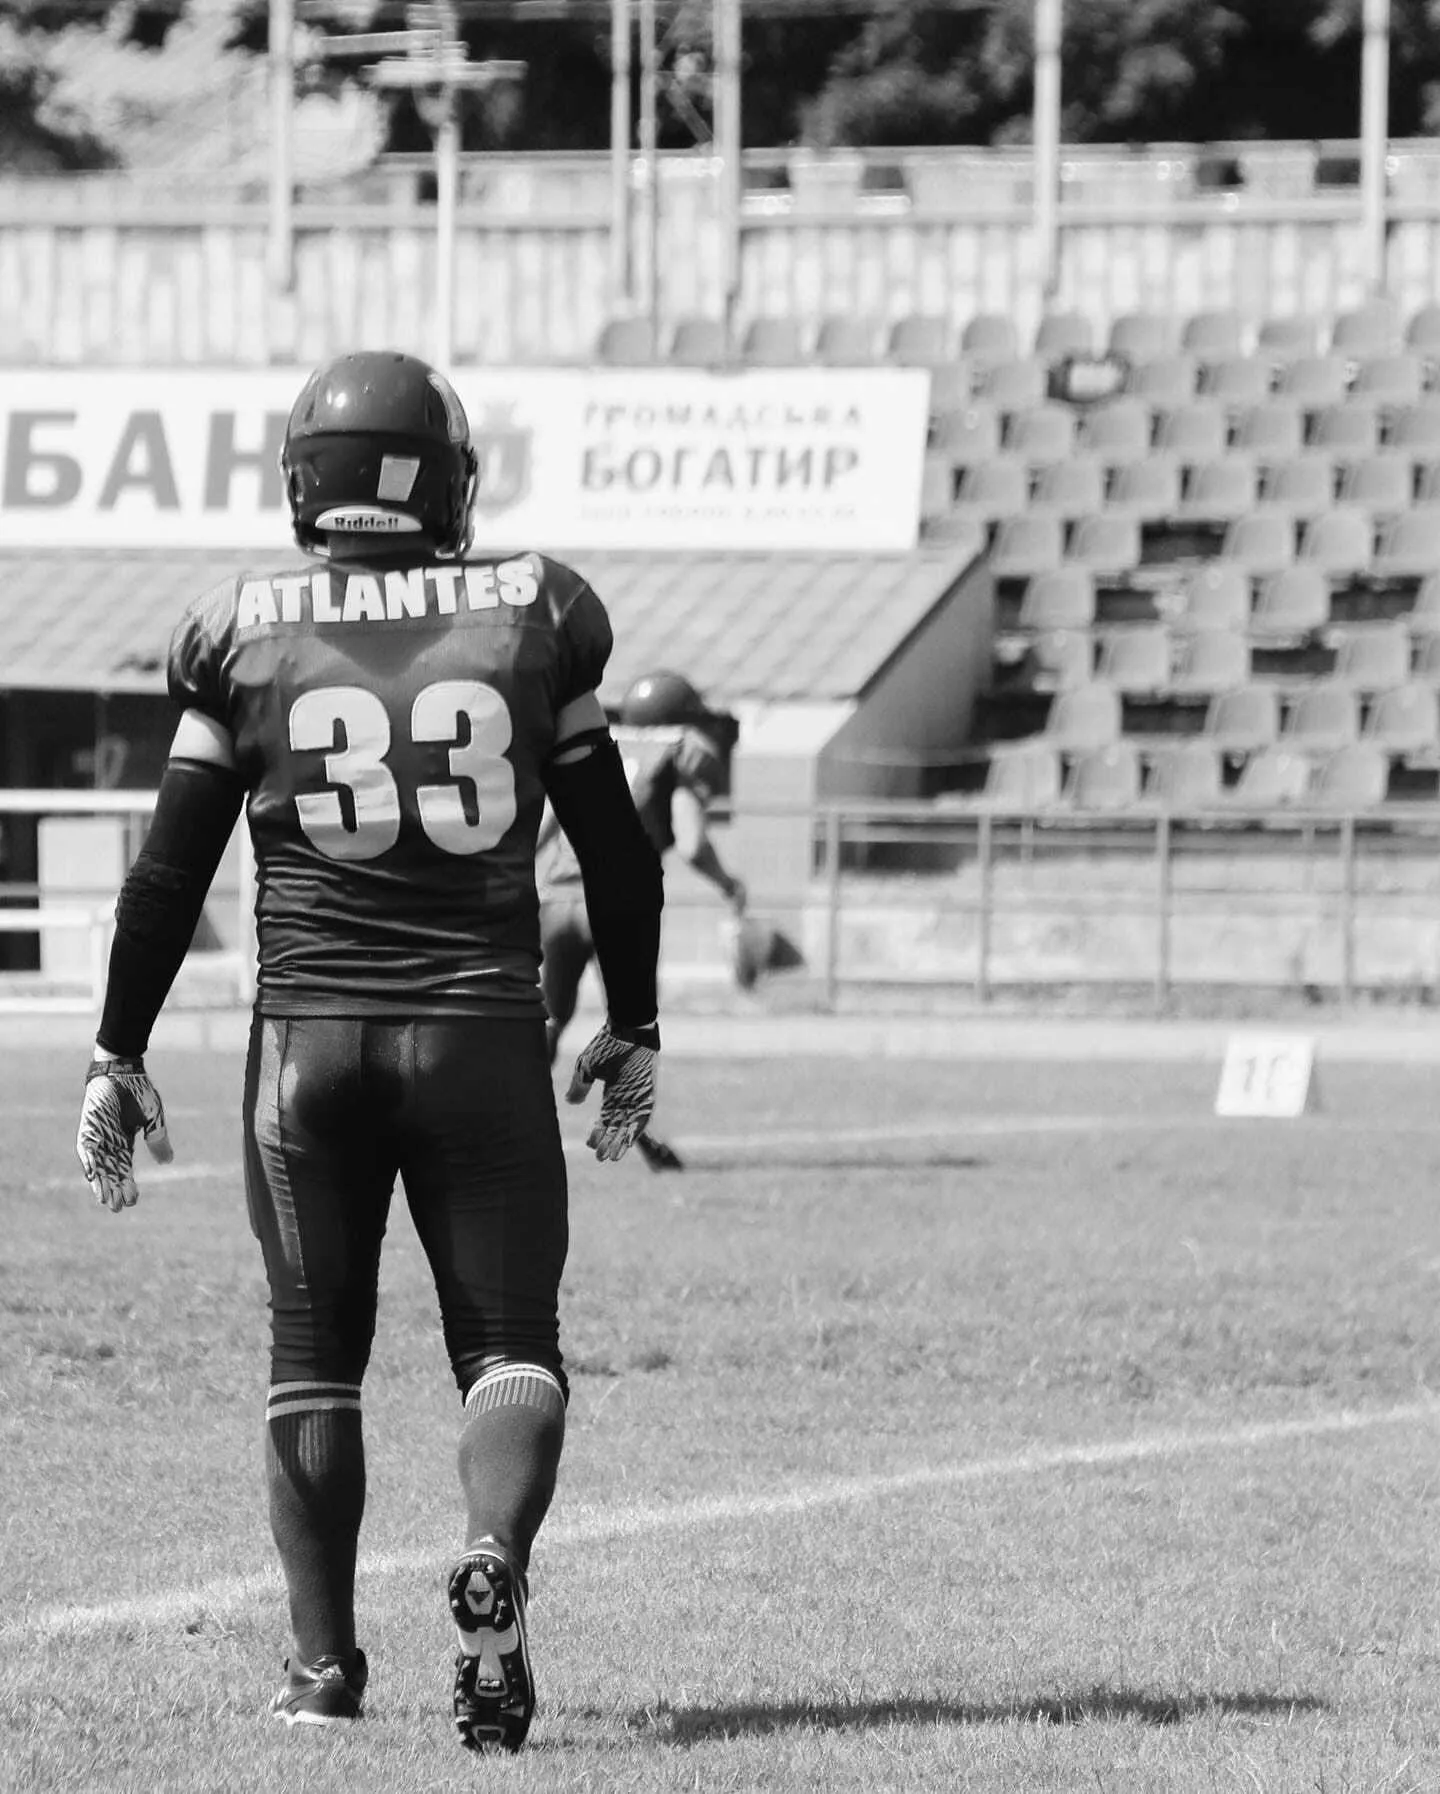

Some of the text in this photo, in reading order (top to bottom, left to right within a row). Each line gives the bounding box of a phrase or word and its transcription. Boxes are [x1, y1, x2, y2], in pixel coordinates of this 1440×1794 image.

[581, 446, 860, 490] БОГАТИР
[334, 516, 399, 530] Riddell
[238, 560, 539, 627] ATLANTES
[289, 679, 517, 861] 33
